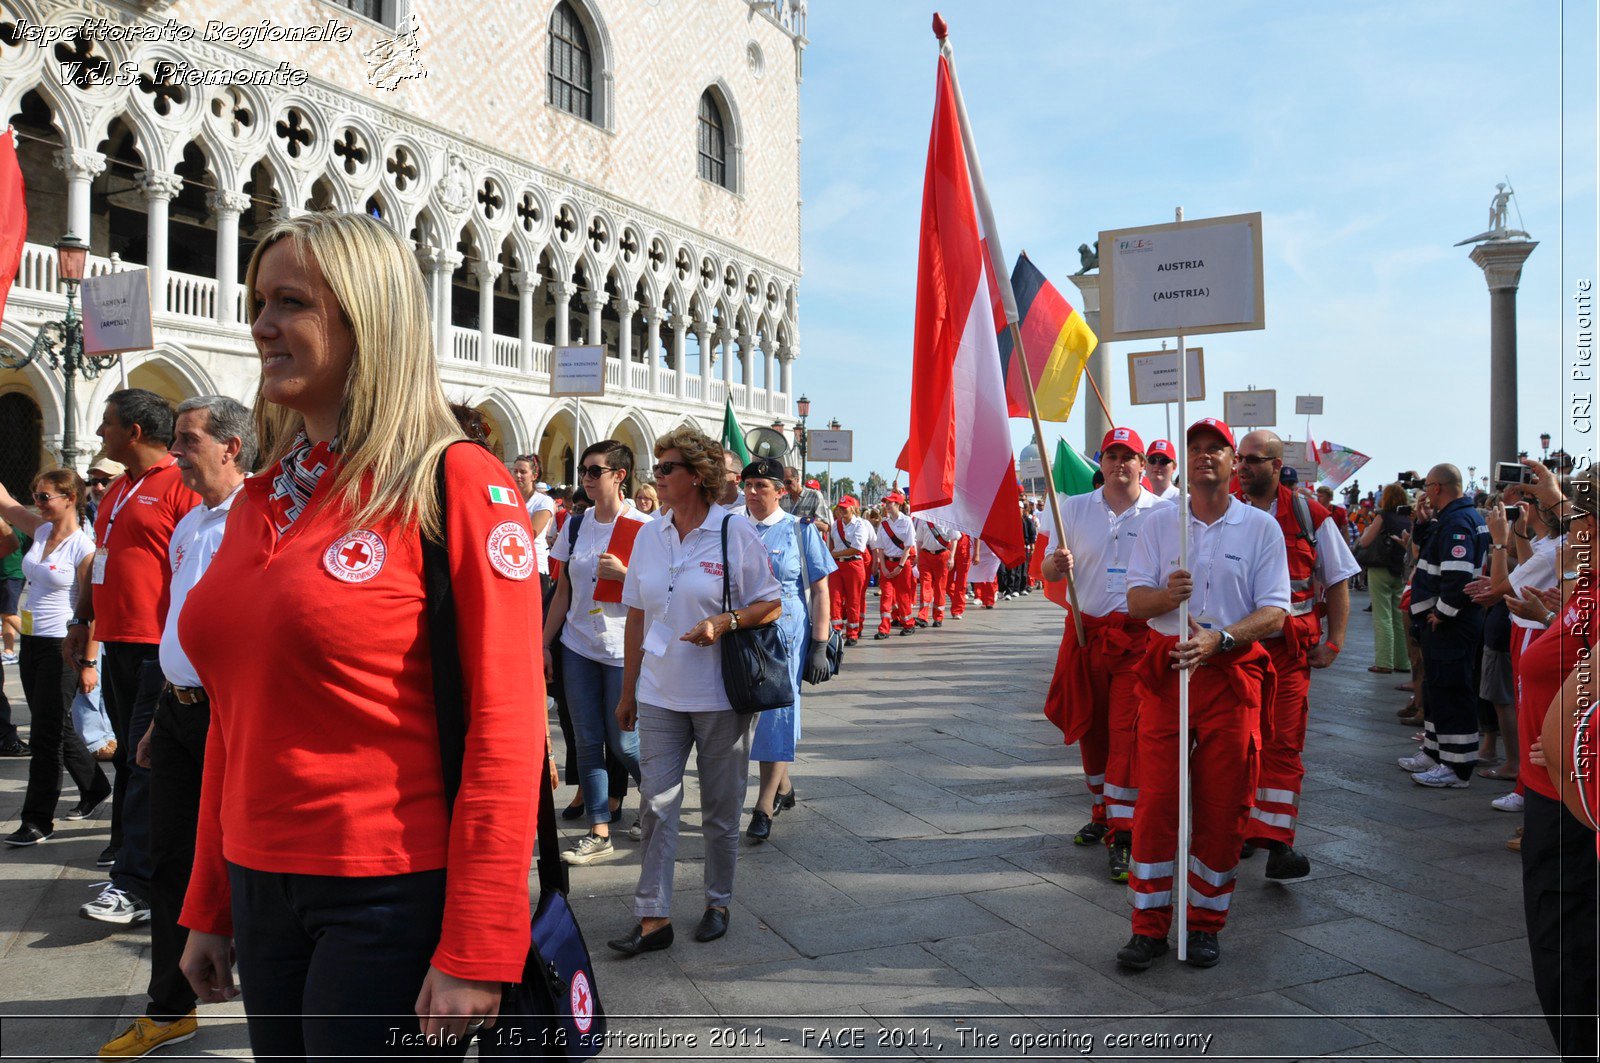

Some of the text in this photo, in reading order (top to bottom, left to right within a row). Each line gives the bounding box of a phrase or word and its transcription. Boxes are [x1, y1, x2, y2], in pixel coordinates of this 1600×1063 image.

[1157, 259, 1205, 272] AUSTRIA
[1152, 287, 1210, 302] (AUSTRIA)
[490, 530, 504, 551] CROCE
[500, 524, 518, 534] ROSSA
[493, 555, 518, 577] COMITATO
